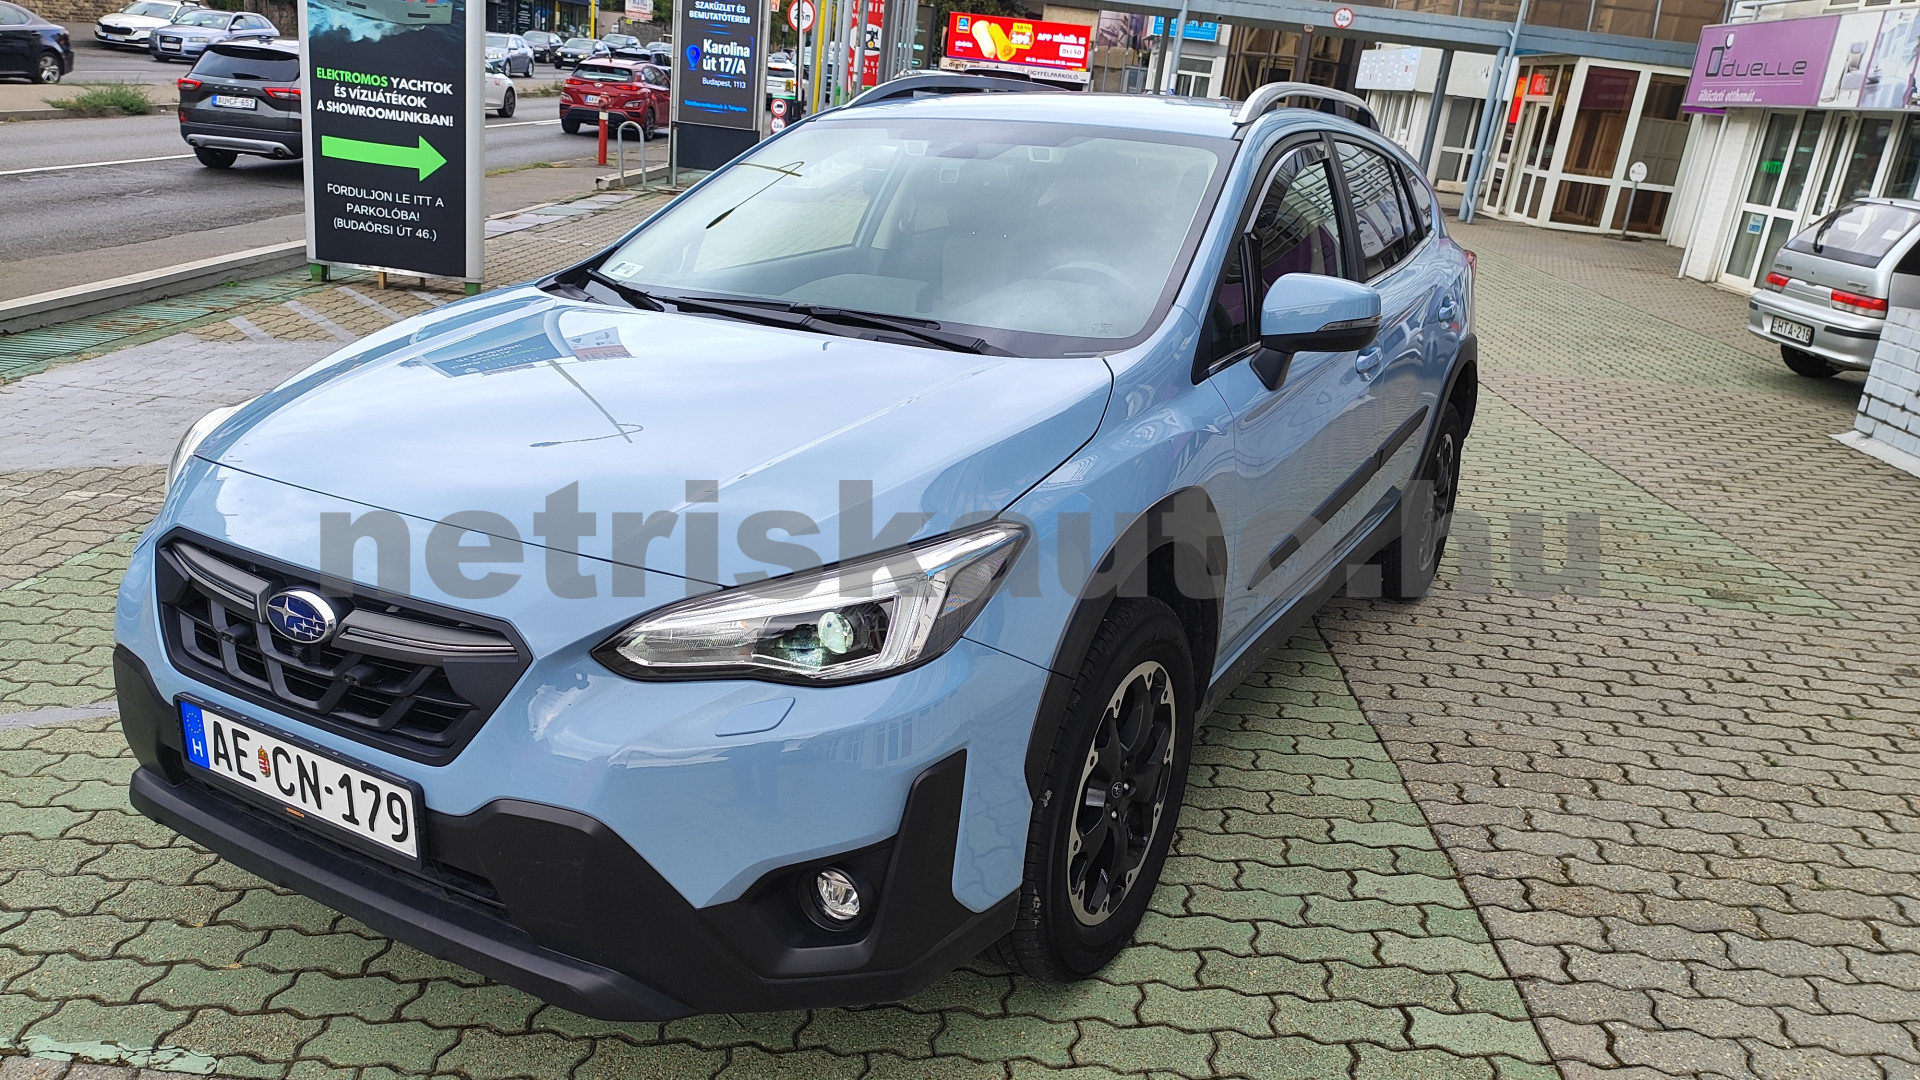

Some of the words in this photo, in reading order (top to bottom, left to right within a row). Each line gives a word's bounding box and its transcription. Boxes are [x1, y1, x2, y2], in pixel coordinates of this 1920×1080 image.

[689, 10, 751, 24] BEMUTATÓTEREM
[695, 1, 735, 12] SZAKÜZLET
[737, 4, 746, 13] ÉS
[703, 38, 750, 58] Karolina
[703, 55, 716, 71] út
[720, 57, 747, 75] 17/A
[316, 66, 389, 87] ELEKTROMOS
[390, 76, 454, 95] YACHTOK
[702, 77, 732, 88] Budapest,
[733, 80, 746, 89] 1113
[334, 83, 347, 98] ÉS
[348, 85, 428, 108] VÍZIJÁTÉKOK
[316, 99, 325, 111] A
[326, 100, 454, 127] SHOWROOMUNKBAN!
[327, 183, 392, 202] FORDULJON
[396, 193, 411, 204] LE
[414, 195, 432, 206] ITT
[435, 197, 445, 208] A
[346, 203, 420, 222] PARKOLÓBA!
[333, 217, 393, 235] (BUDAÖRSI
[396, 225, 413, 237] ÚT
[415, 228, 437, 242] 46.)
[192, 738, 204, 758] H
[213, 720, 256, 783] AE
[272, 746, 409, 843] CN-179
